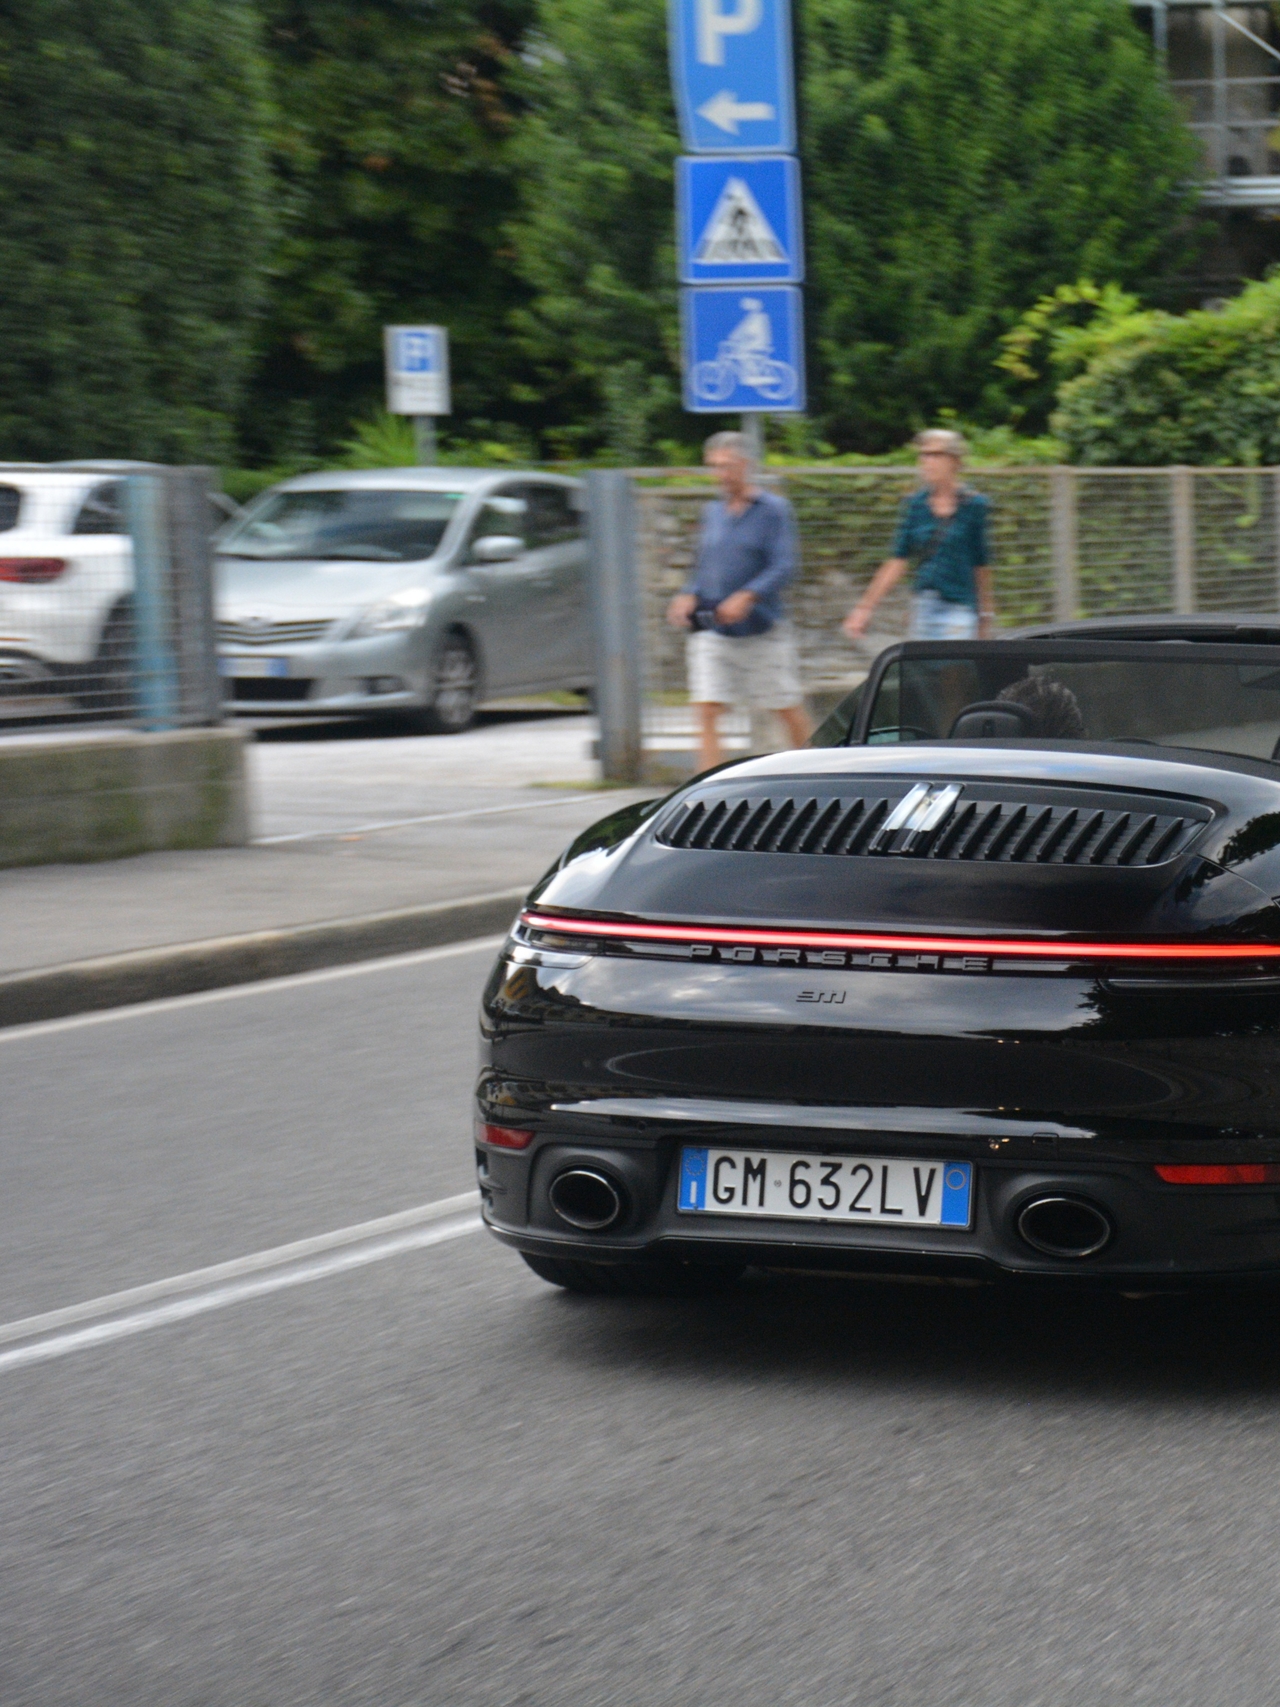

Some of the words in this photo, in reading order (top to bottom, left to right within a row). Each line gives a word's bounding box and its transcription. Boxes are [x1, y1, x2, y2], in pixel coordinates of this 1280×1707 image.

[697, 0, 762, 66] P
[690, 944, 989, 972] PORSCHE
[796, 990, 847, 1004] 911
[712, 1155, 767, 1208] GM
[788, 1160, 937, 1217] 632LV
